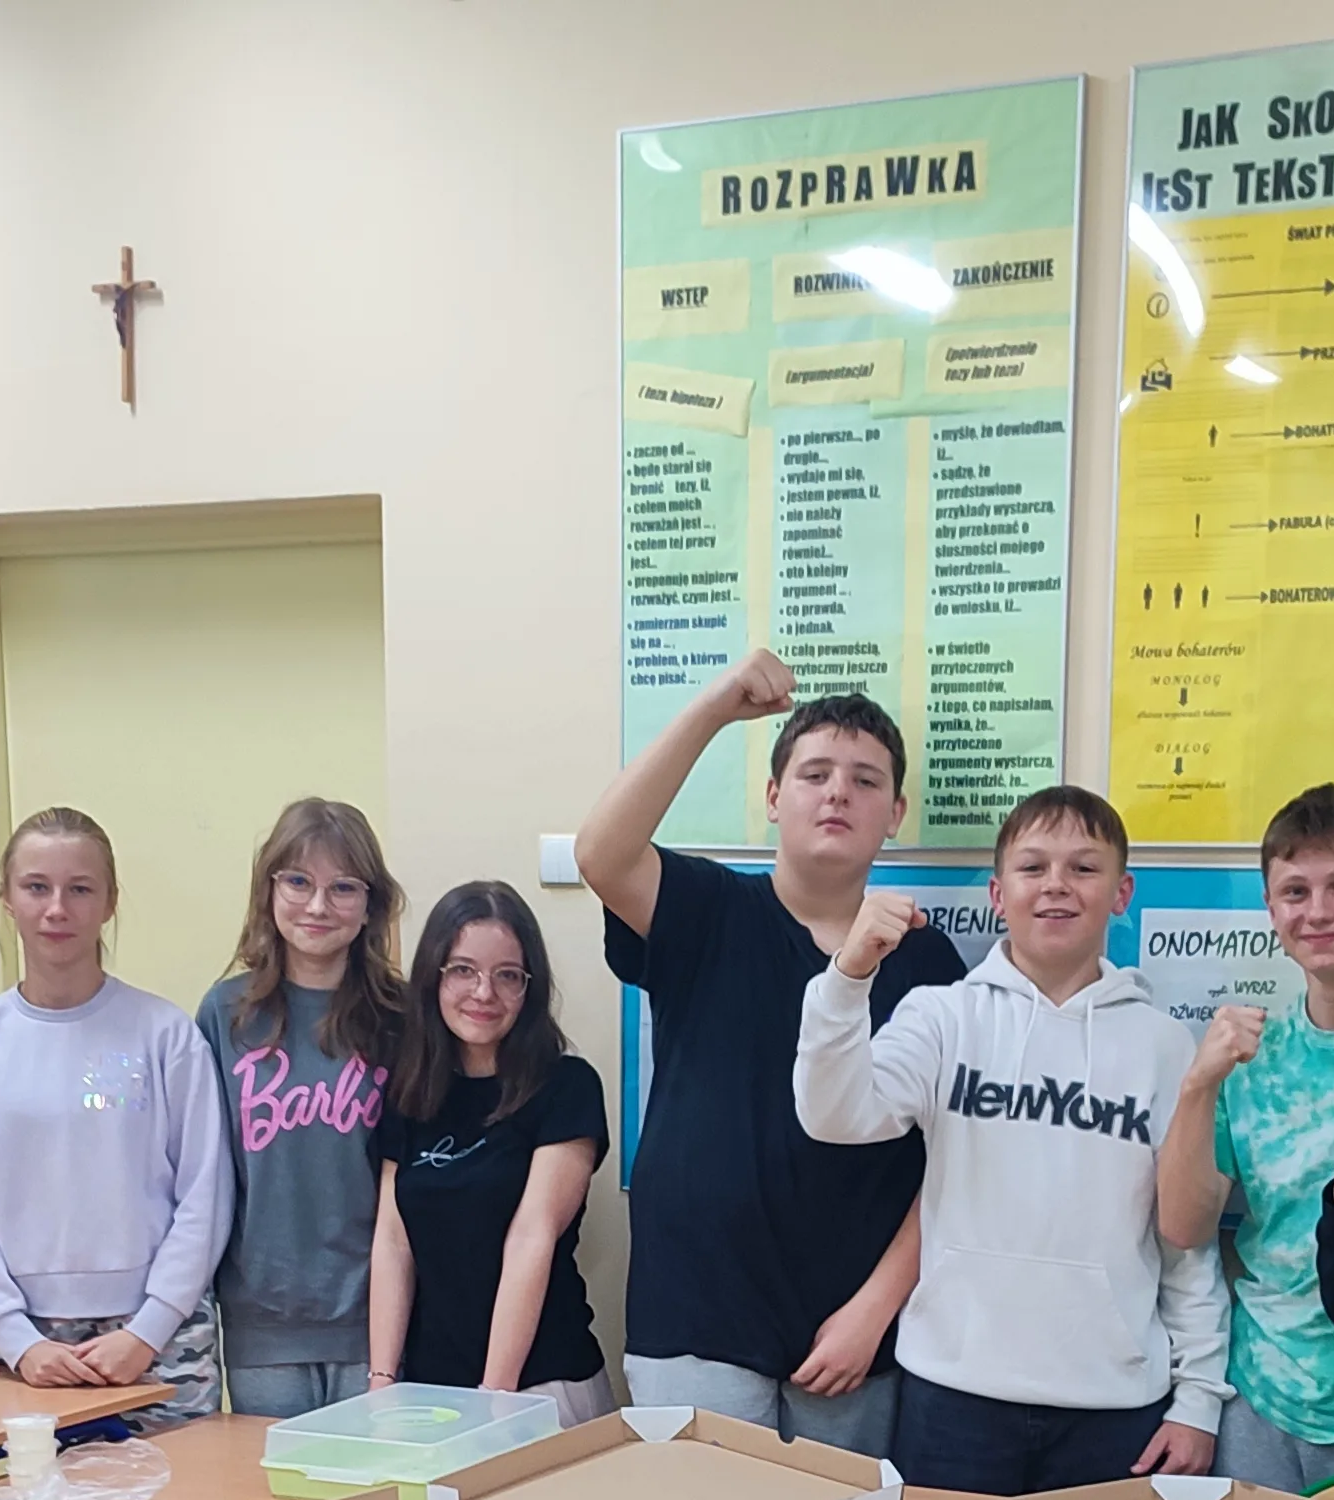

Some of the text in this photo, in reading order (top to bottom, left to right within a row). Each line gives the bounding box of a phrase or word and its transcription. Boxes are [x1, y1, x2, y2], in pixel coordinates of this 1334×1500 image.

[1177, 103, 1241, 152] JAK
[721, 150, 976, 216] ROZPRAWKA
[1142, 168, 1214, 213] JEST
[952, 257, 1055, 287] ZAKOŃCZENIE
[661, 286, 709, 309] WSTĘP
[1148, 929, 1282, 959] ONOMATOP
[1234, 979, 1277, 996] WYRAZ
[232, 1046, 389, 1151] Barbi
